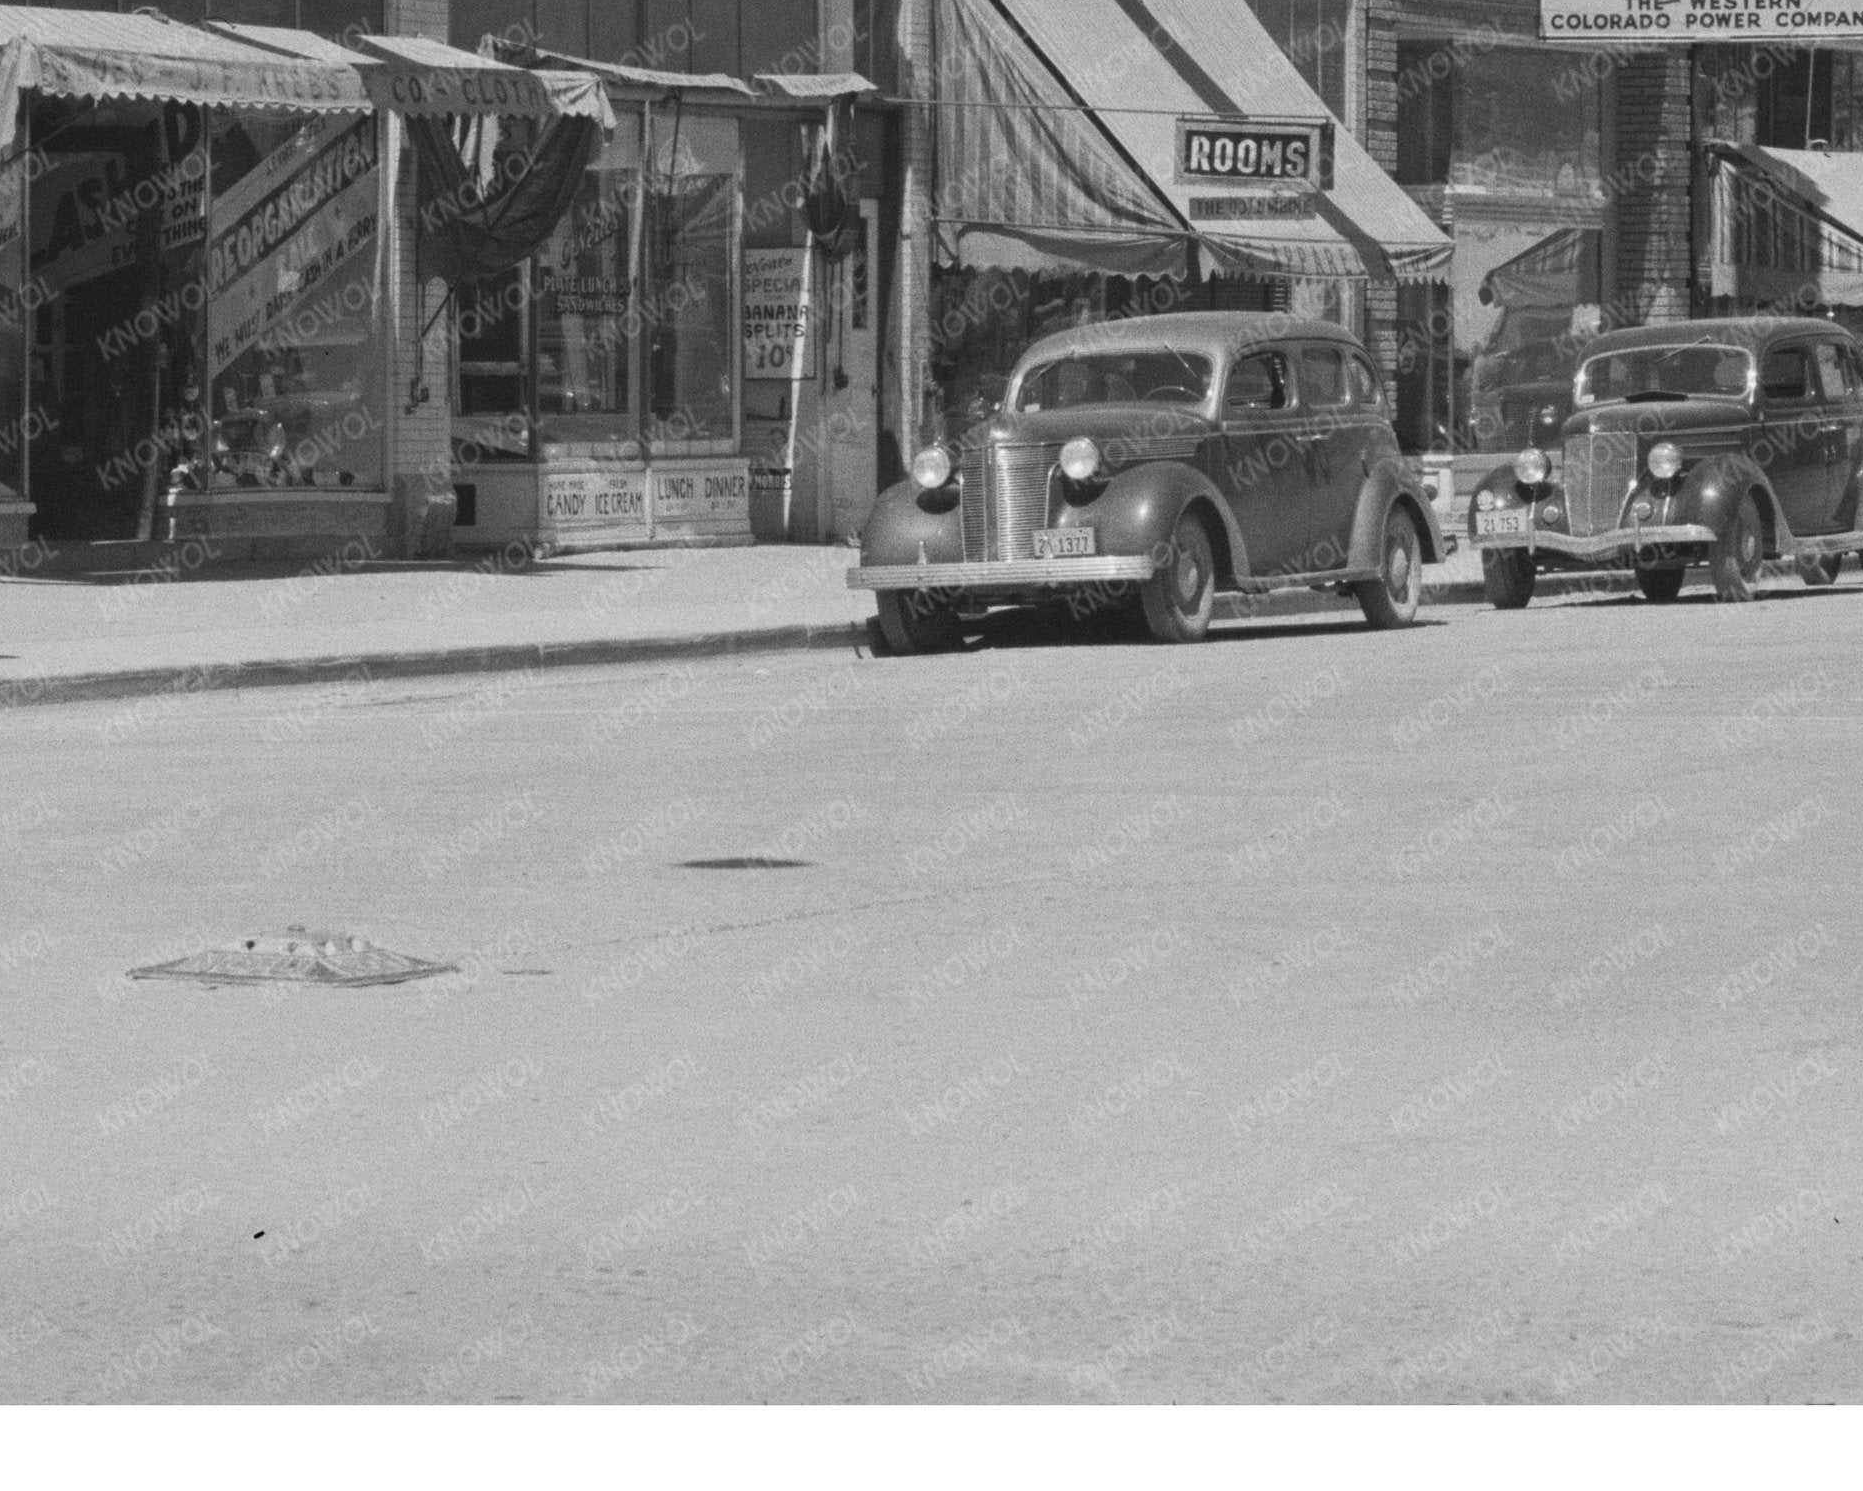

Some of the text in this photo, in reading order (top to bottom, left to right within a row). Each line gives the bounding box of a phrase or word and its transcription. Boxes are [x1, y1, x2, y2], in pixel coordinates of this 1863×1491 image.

[1550, 13, 1671, 30] COLORADO
[1686, 12, 1762, 29] POWER
[1189, 134, 1306, 177] ROOMS
[1197, 200, 1223, 215] THE
[581, 276, 617, 293] LUNCH
[557, 295, 625, 313] SANDWICHES
[745, 304, 810, 320] BANANA
[745, 323, 804, 339] SPLITS
[657, 477, 694, 501] LUNCH
[704, 475, 745, 499] DINNER
[546, 493, 587, 516] CANDY
[595, 492, 610, 515] ICE
[611, 491, 643, 514] CREAM
[1058, 536, 1089, 553] 1377
